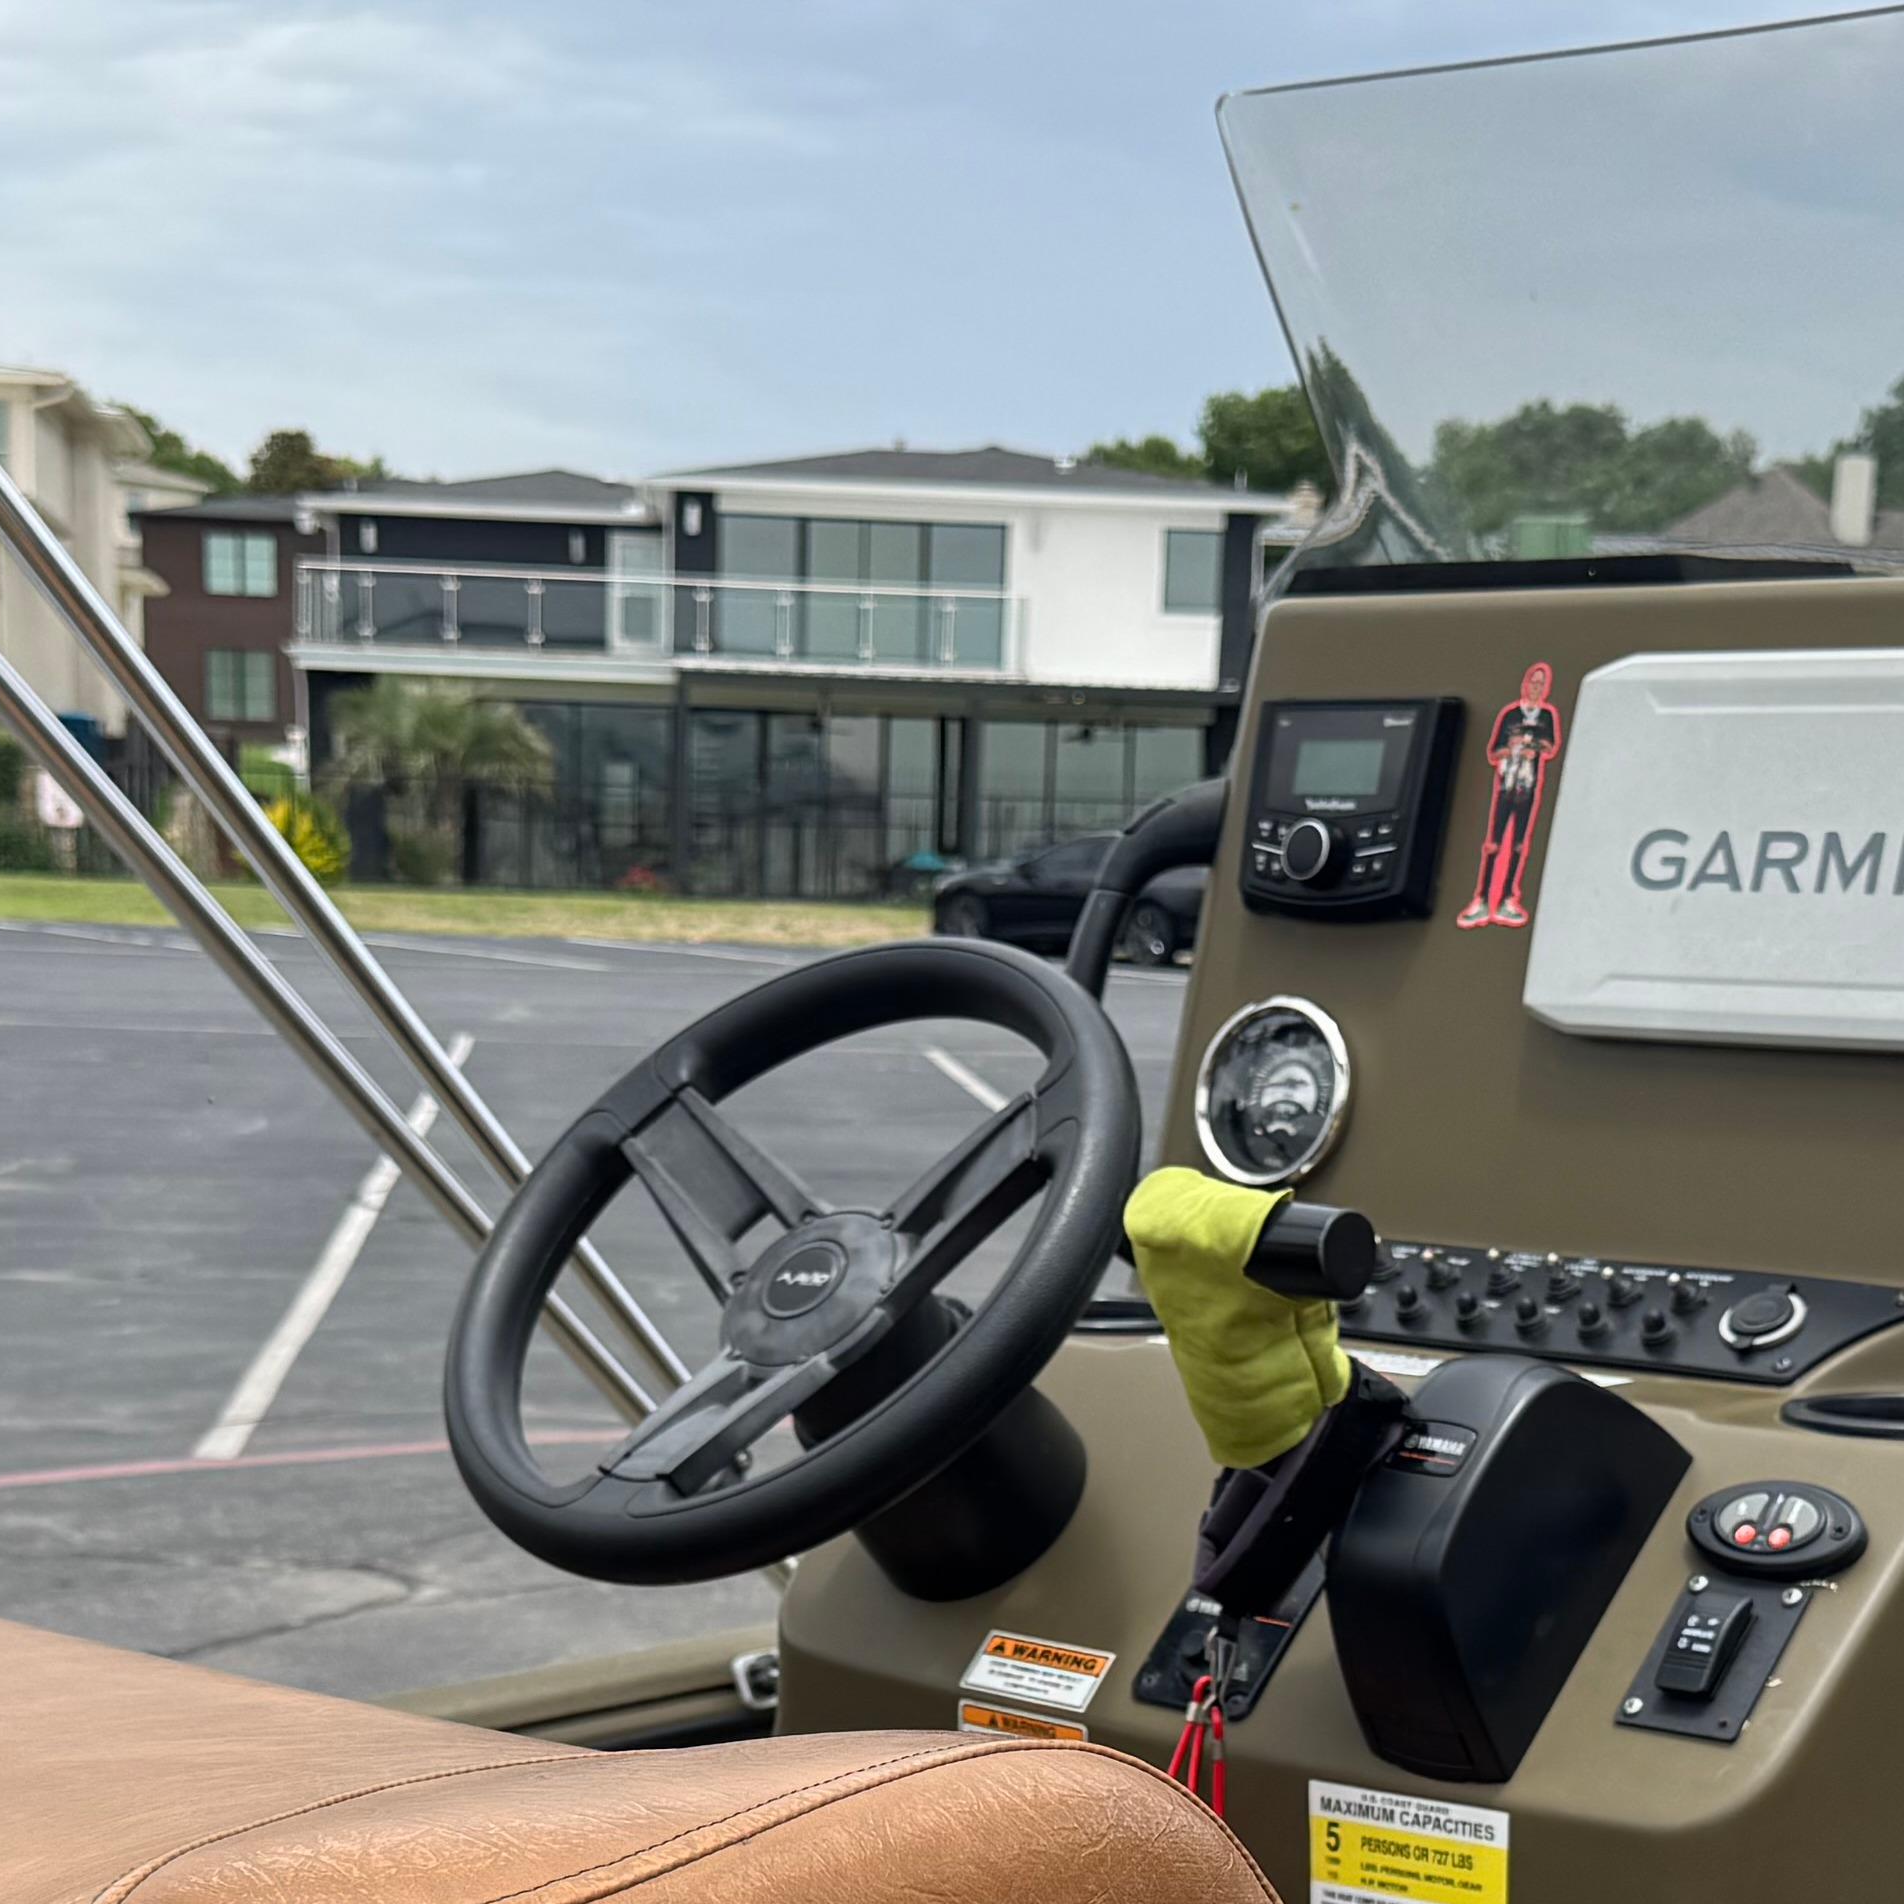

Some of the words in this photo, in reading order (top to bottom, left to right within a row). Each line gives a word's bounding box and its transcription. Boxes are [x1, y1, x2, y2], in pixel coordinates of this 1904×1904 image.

[1013, 1643, 1096, 1671] WARNING
[1319, 1796, 1395, 1826] MAXIMUM
[1399, 1811, 1495, 1841] CAPACITIES
[1379, 1797, 1412, 1808] COAST
[1415, 1802, 1450, 1815] GUARD
[1325, 1821, 1341, 1852] 5
[1360, 1836, 1411, 1860] PERSONS
[1413, 1845, 1429, 1862] OR
[1451, 1852, 1474, 1871] LBS
